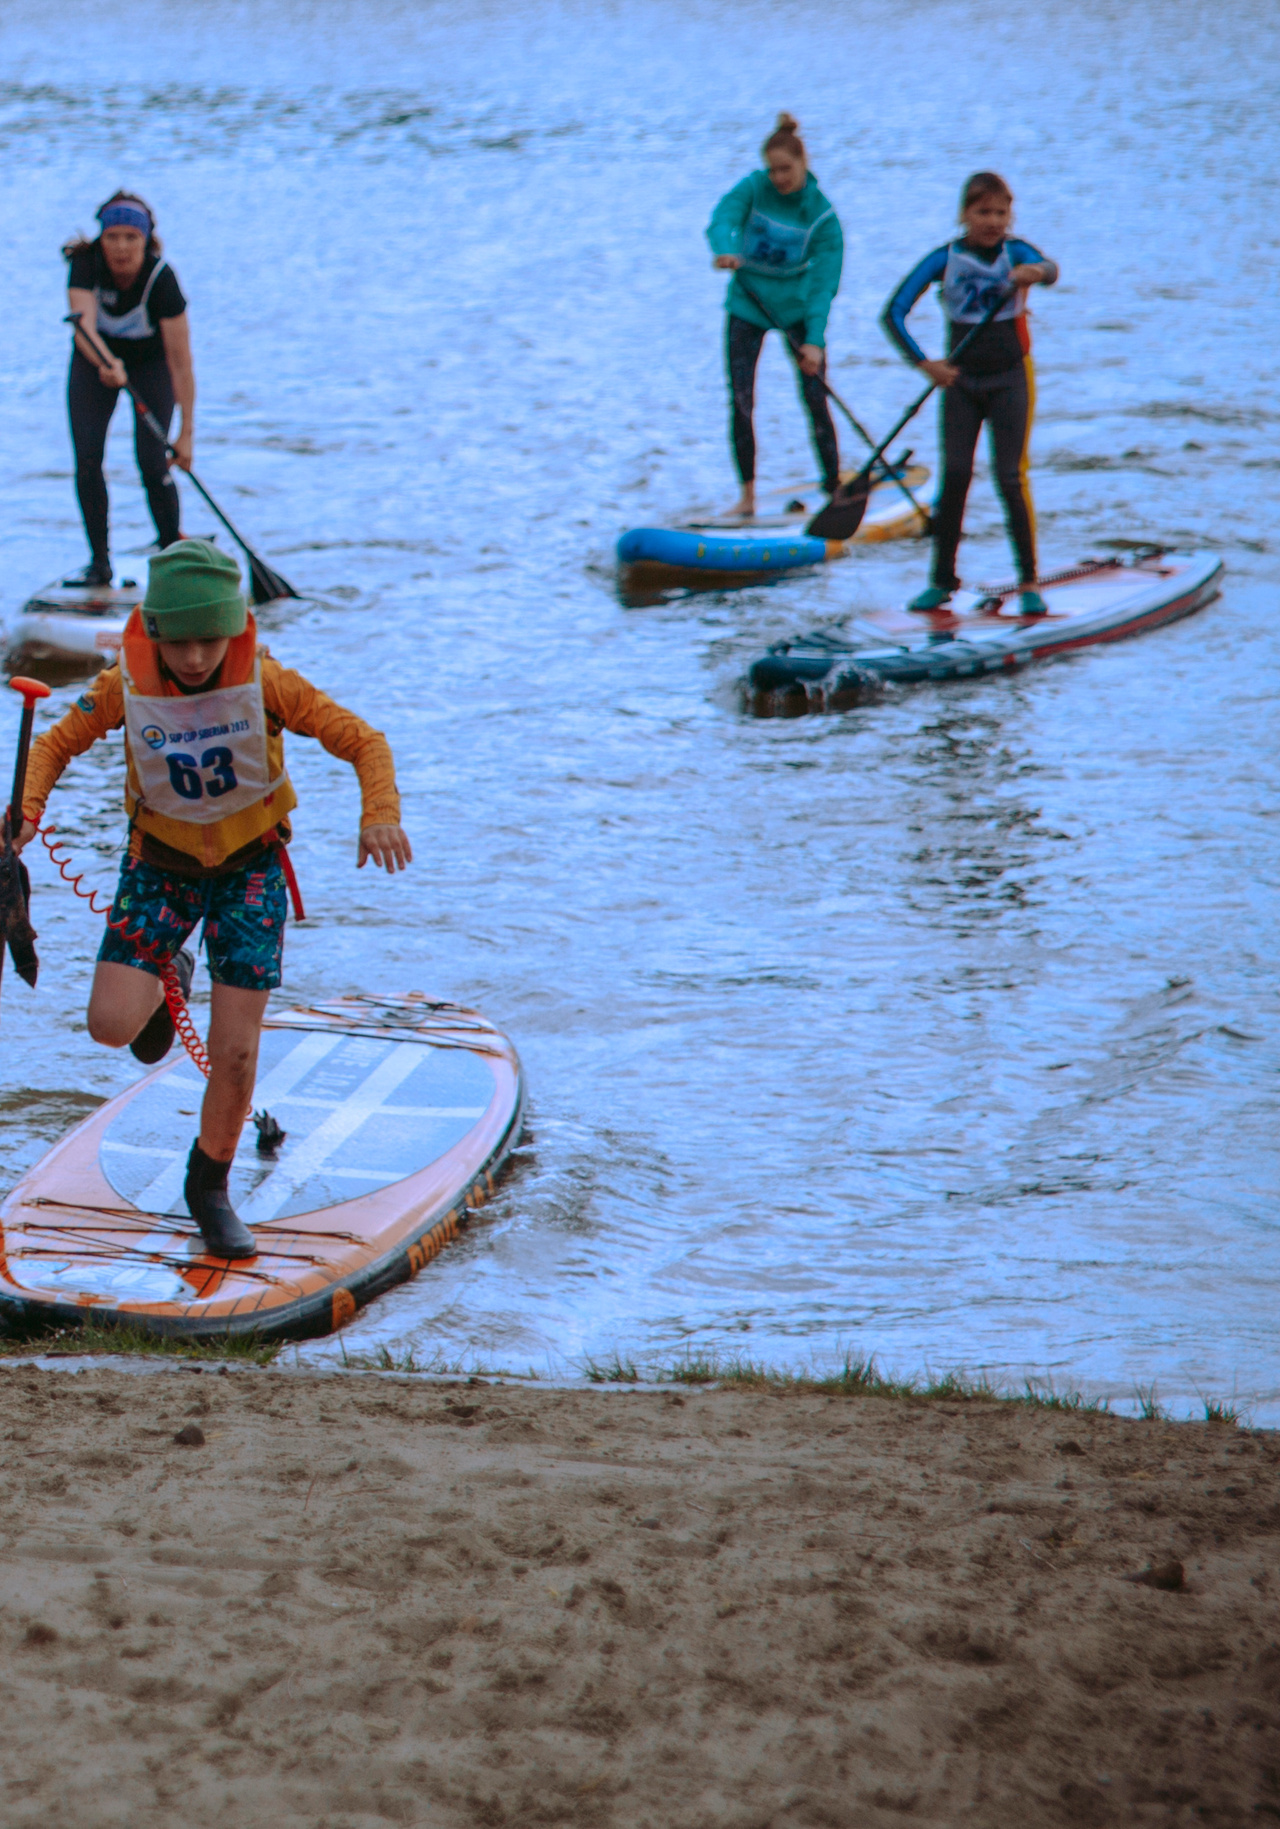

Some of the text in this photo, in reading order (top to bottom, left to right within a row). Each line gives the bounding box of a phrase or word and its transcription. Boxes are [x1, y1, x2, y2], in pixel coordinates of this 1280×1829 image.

[169, 719, 250, 744] SUP CUP SIBERIAN 2023
[165, 746, 239, 800] 63
